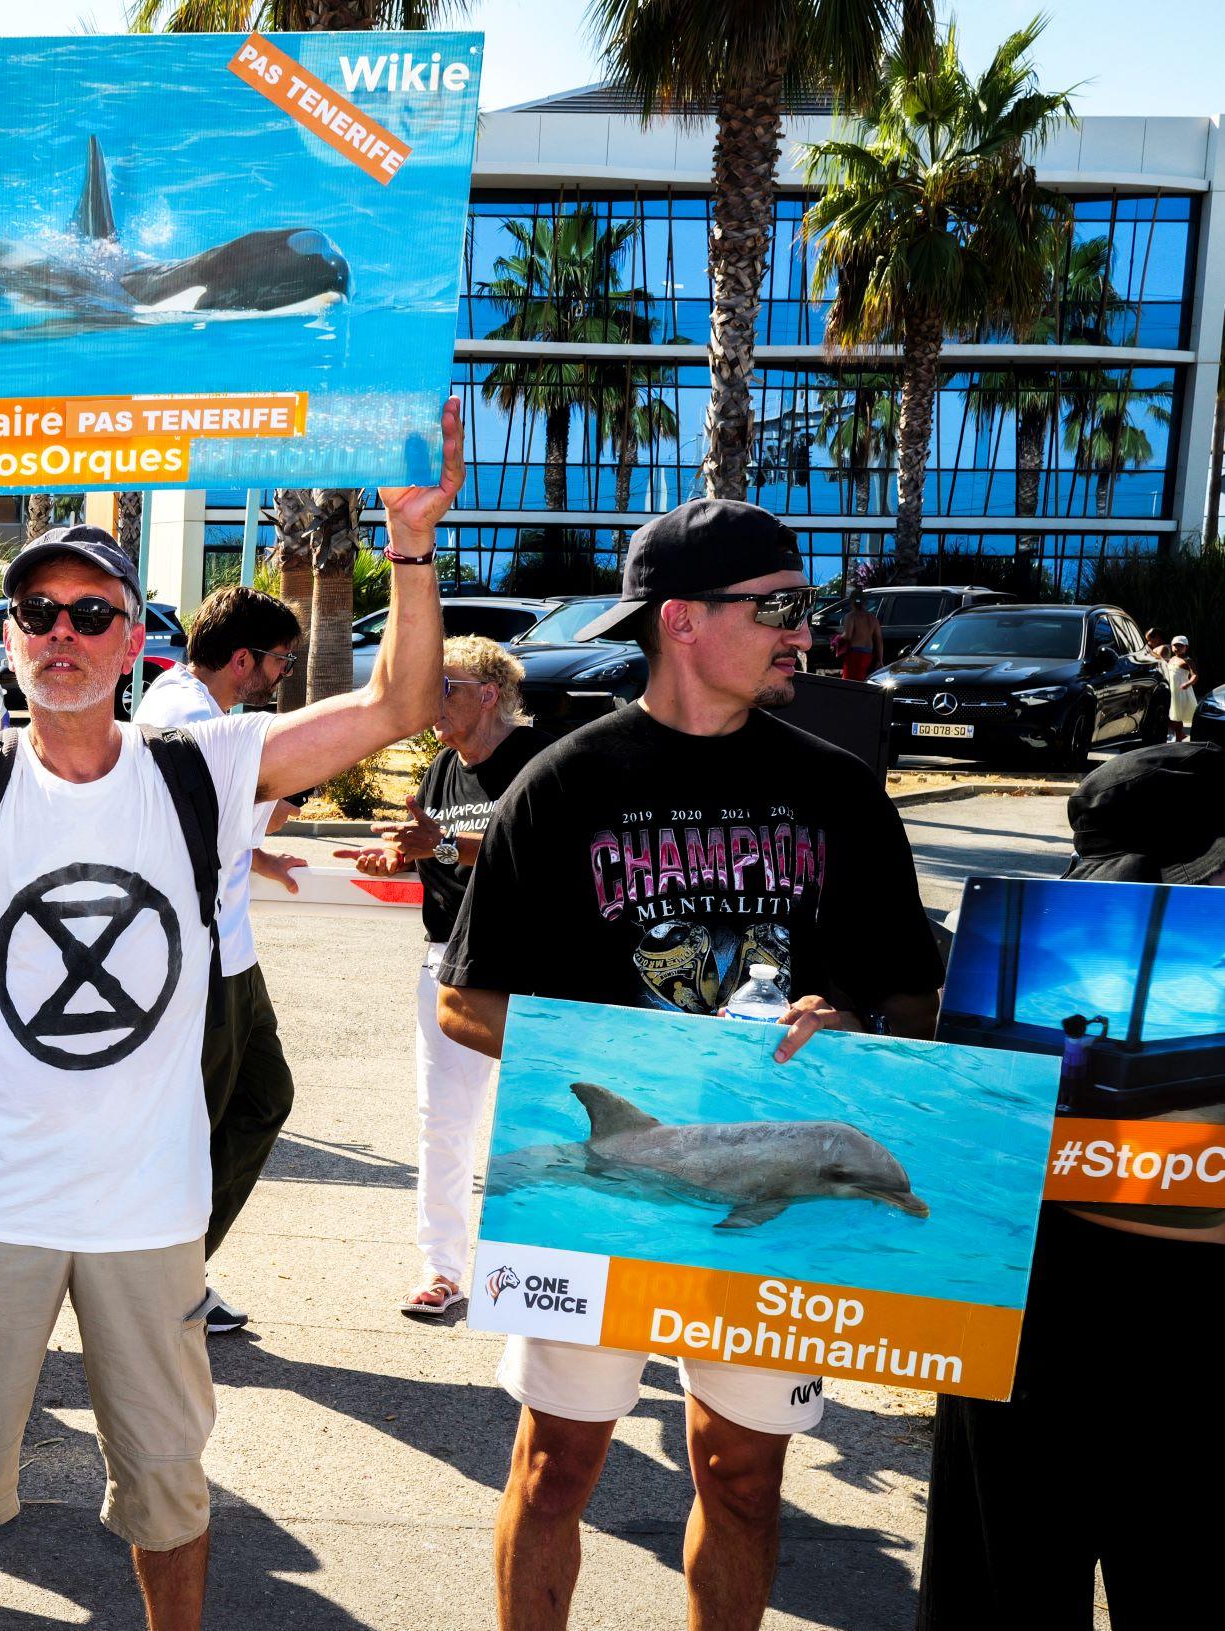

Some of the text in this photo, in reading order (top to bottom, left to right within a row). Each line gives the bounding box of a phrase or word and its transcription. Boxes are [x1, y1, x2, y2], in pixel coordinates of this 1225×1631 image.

[338, 52, 470, 92] Wikie
[238, 44, 405, 175] PAS TENERIFE
[78, 411, 133, 432] PAS
[143, 408, 289, 431] TENERIFE
[622, 811, 653, 824] 2019
[671, 810, 702, 820] 2020
[721, 809, 750, 819] 2021
[590, 823, 825, 922] CHAMPION
[1052, 1140, 1225, 1190] #StopC
[523, 1292, 588, 1316] VOICE
[524, 1275, 569, 1296] ONE
[755, 1279, 865, 1328] Stop
[649, 1308, 963, 1384] Delphinarium
